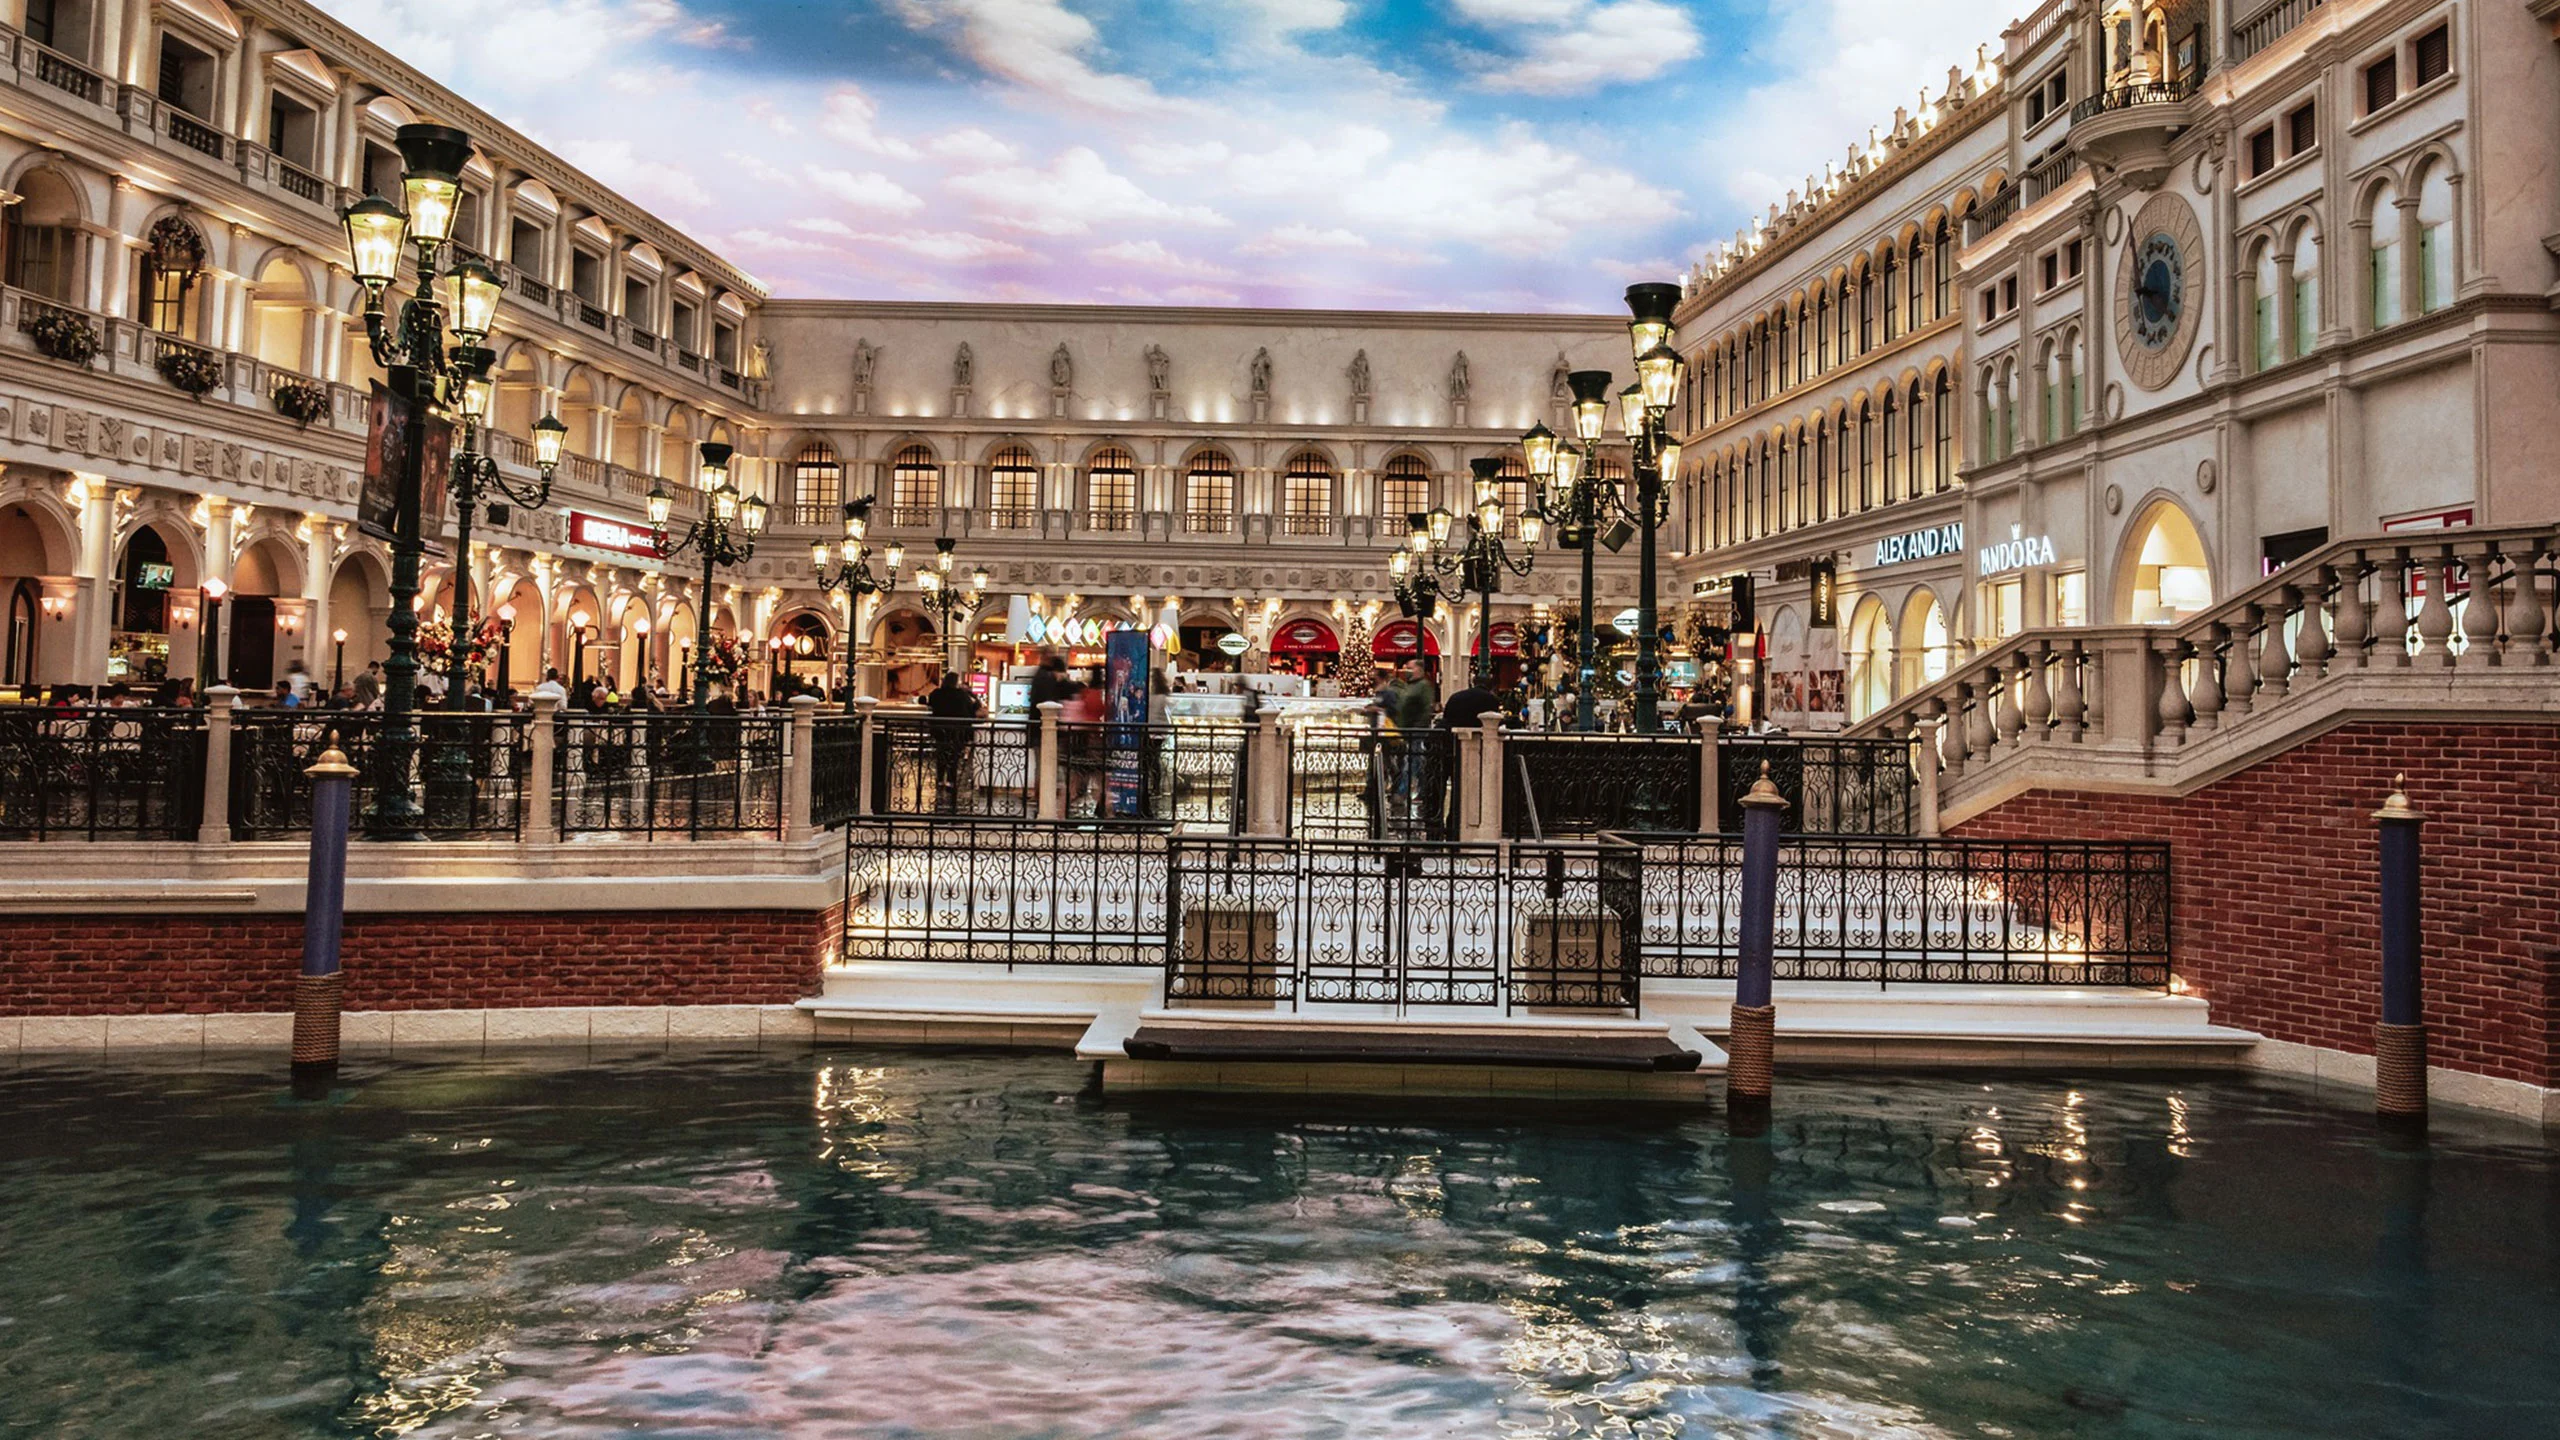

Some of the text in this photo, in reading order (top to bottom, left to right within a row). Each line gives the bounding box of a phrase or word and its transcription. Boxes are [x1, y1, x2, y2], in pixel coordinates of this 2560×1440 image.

[1875, 535, 1906, 566] ALEX
[1908, 528, 1938, 560] AND
[1981, 535, 2055, 576] PANDORA
[1819, 586, 1828, 602] AND
[1819, 603, 1828, 621] ALEX
